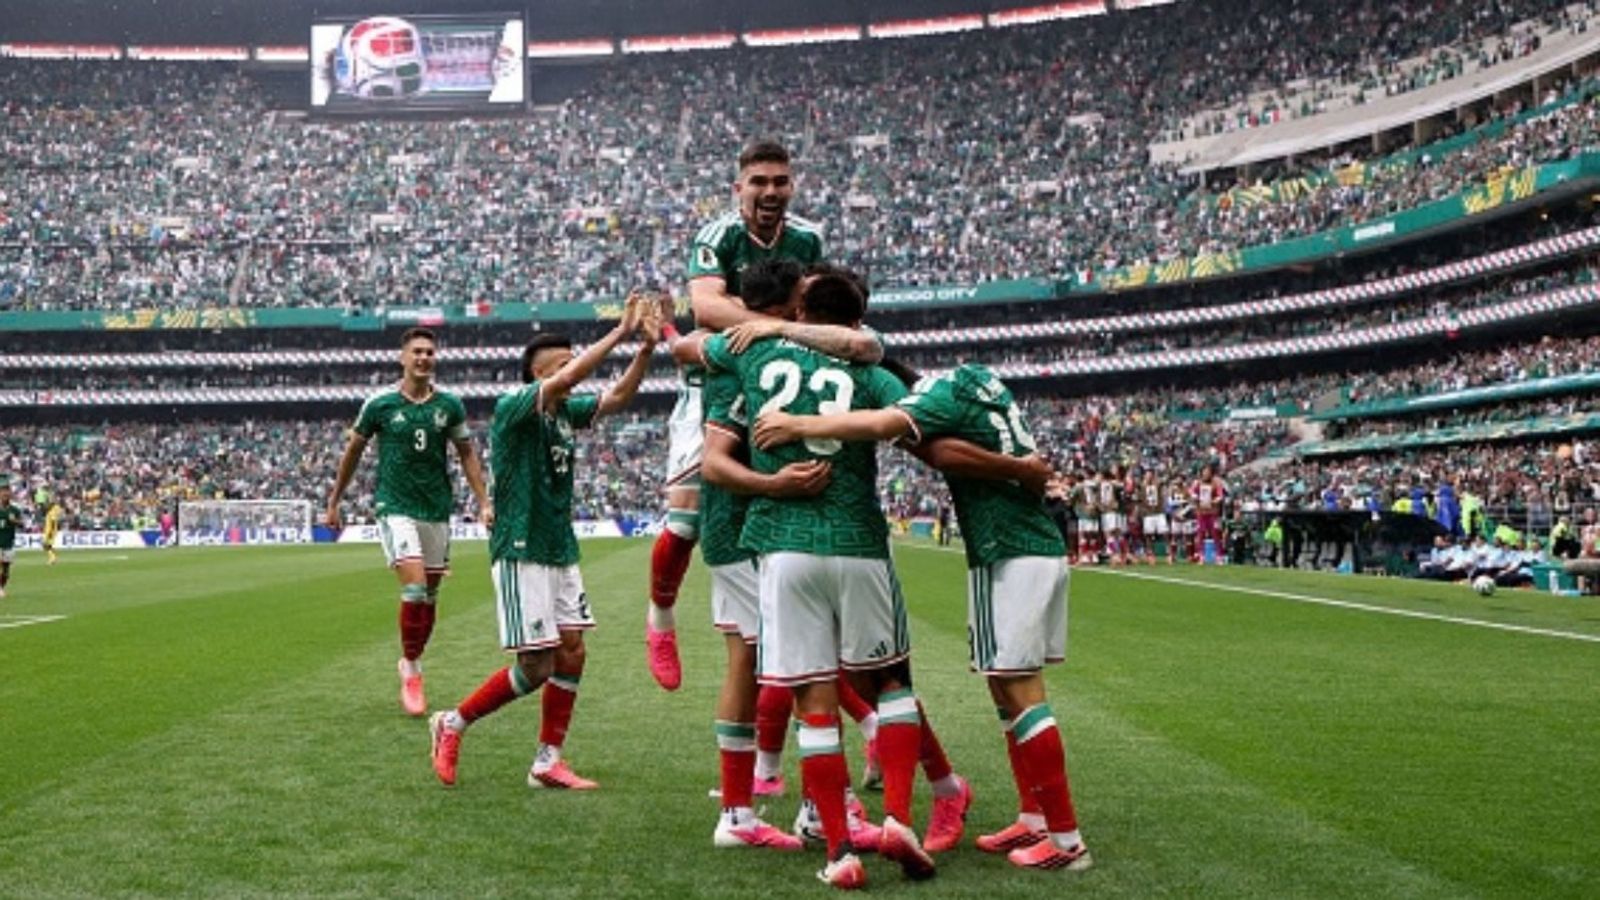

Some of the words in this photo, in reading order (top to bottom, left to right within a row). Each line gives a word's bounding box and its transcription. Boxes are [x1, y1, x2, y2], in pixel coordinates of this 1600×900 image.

[937, 286, 978, 300] CITY
[757, 359, 854, 455] 23
[414, 428, 427, 451] 3
[62, 531, 120, 546] BEER
